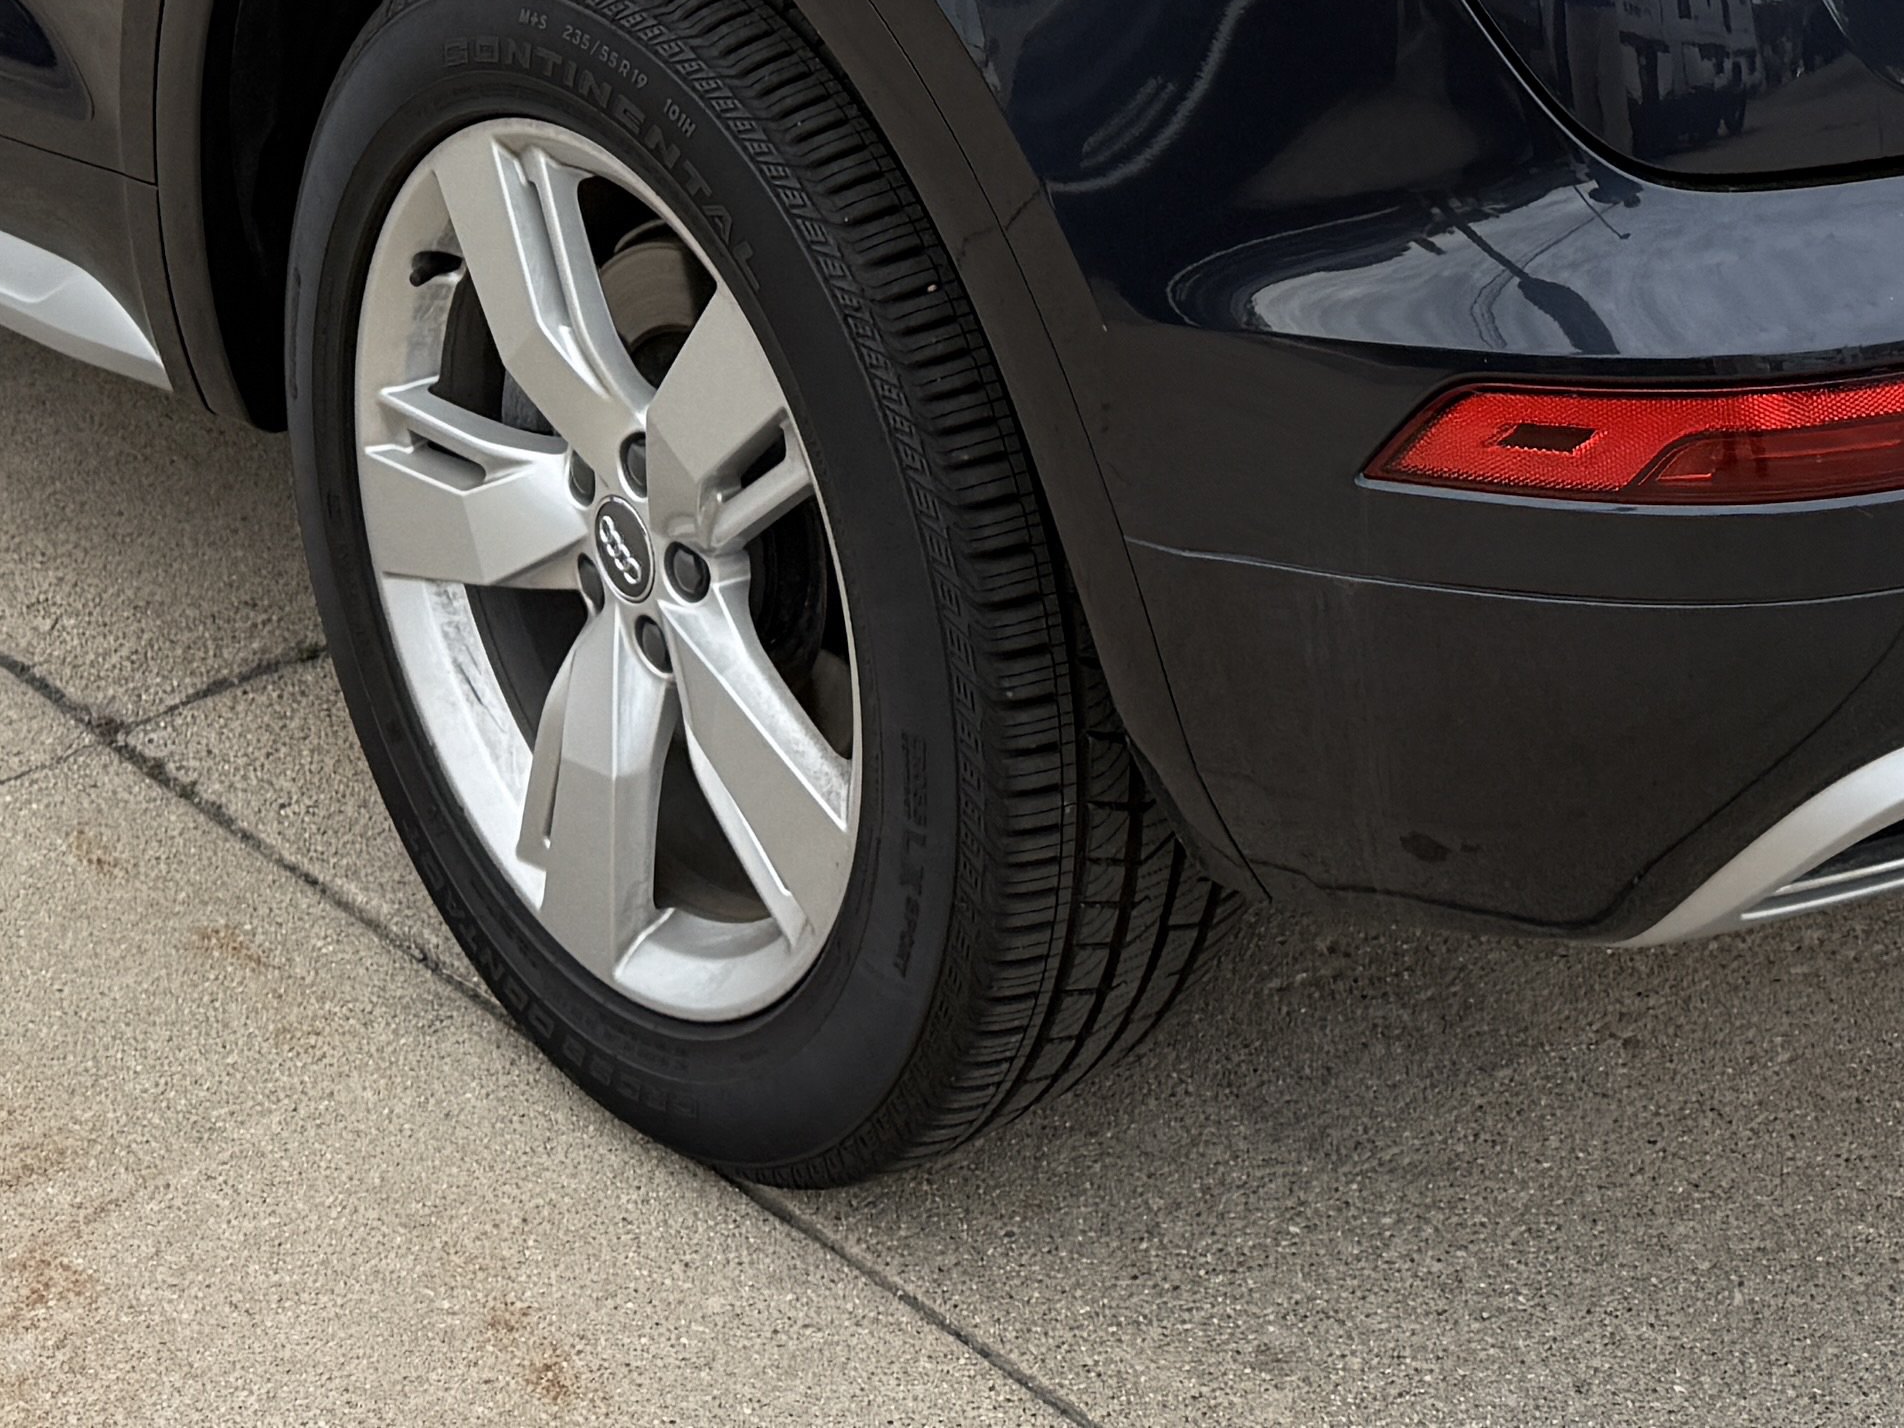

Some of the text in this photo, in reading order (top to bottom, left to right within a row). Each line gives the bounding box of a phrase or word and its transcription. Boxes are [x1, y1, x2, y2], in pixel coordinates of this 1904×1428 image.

[445, 35, 761, 293] CONTINENTAL
[518, 7, 547, 30] M+S
[663, 97, 696, 139] 101H
